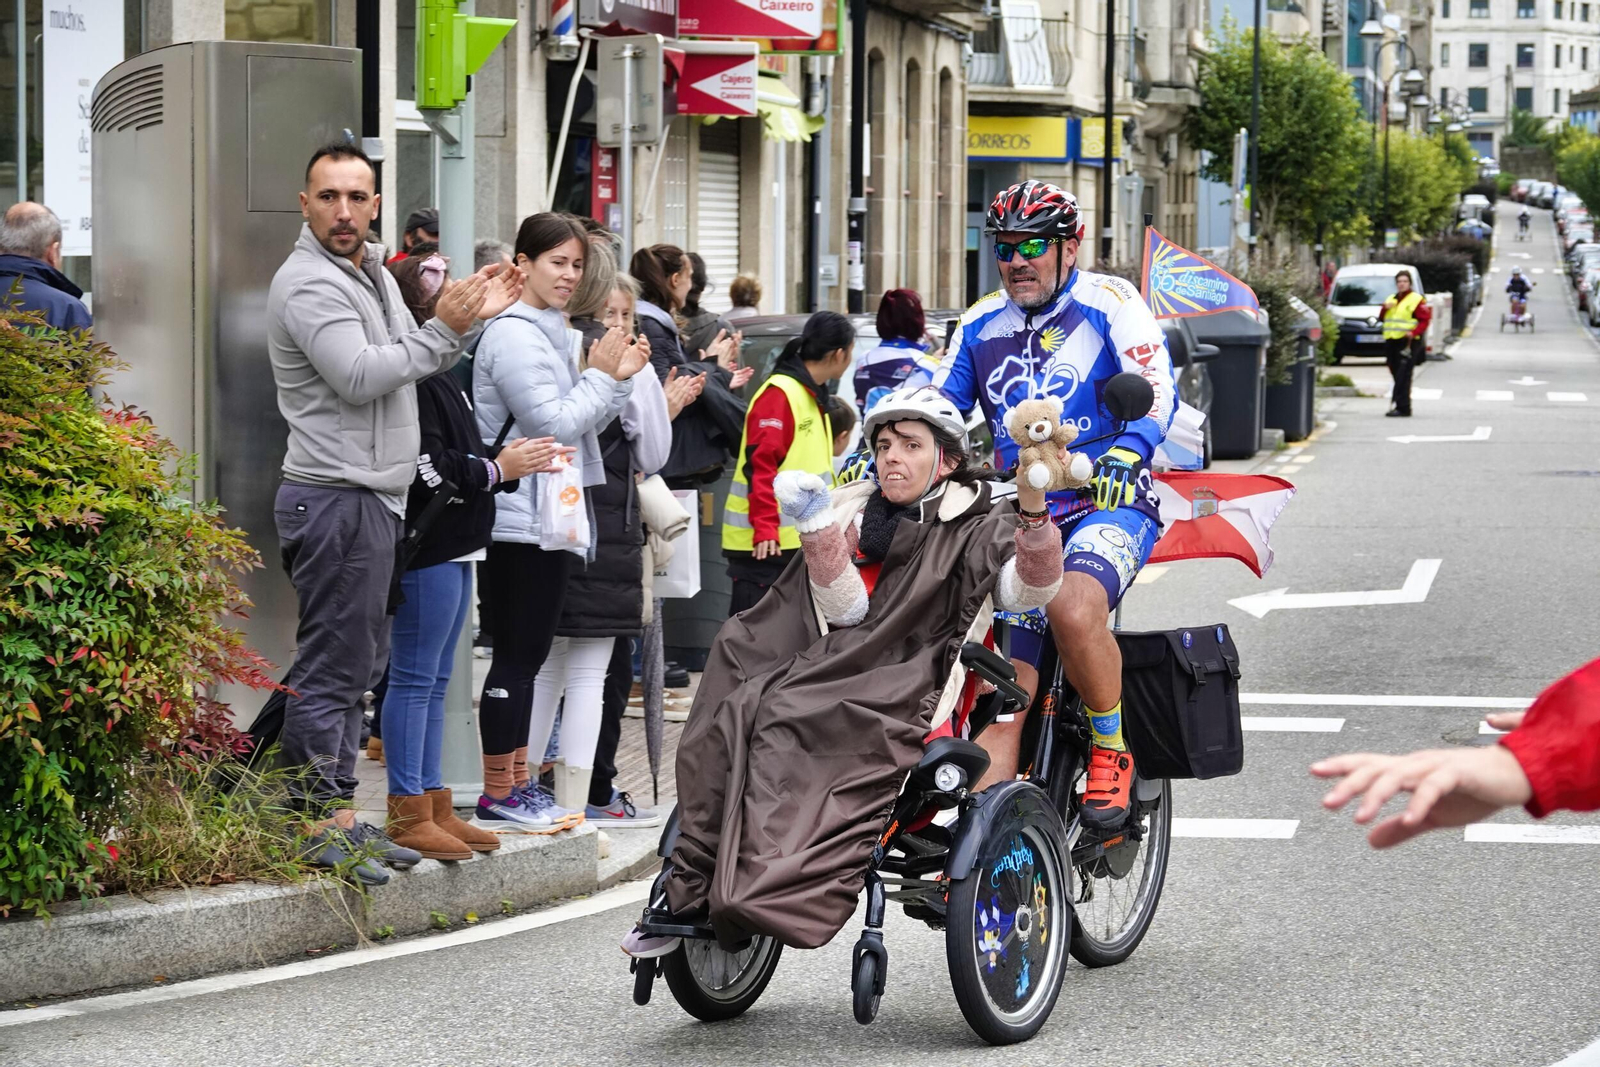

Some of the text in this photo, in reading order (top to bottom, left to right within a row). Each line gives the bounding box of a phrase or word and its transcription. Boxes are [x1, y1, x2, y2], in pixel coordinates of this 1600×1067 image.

[759, 0, 814, 11] Caixeiro
[720, 73, 753, 85] Cajero
[1178, 269, 1229, 292] discamino
[1175, 285, 1228, 305] de Santiago
[1072, 558, 1104, 572] ZICO
